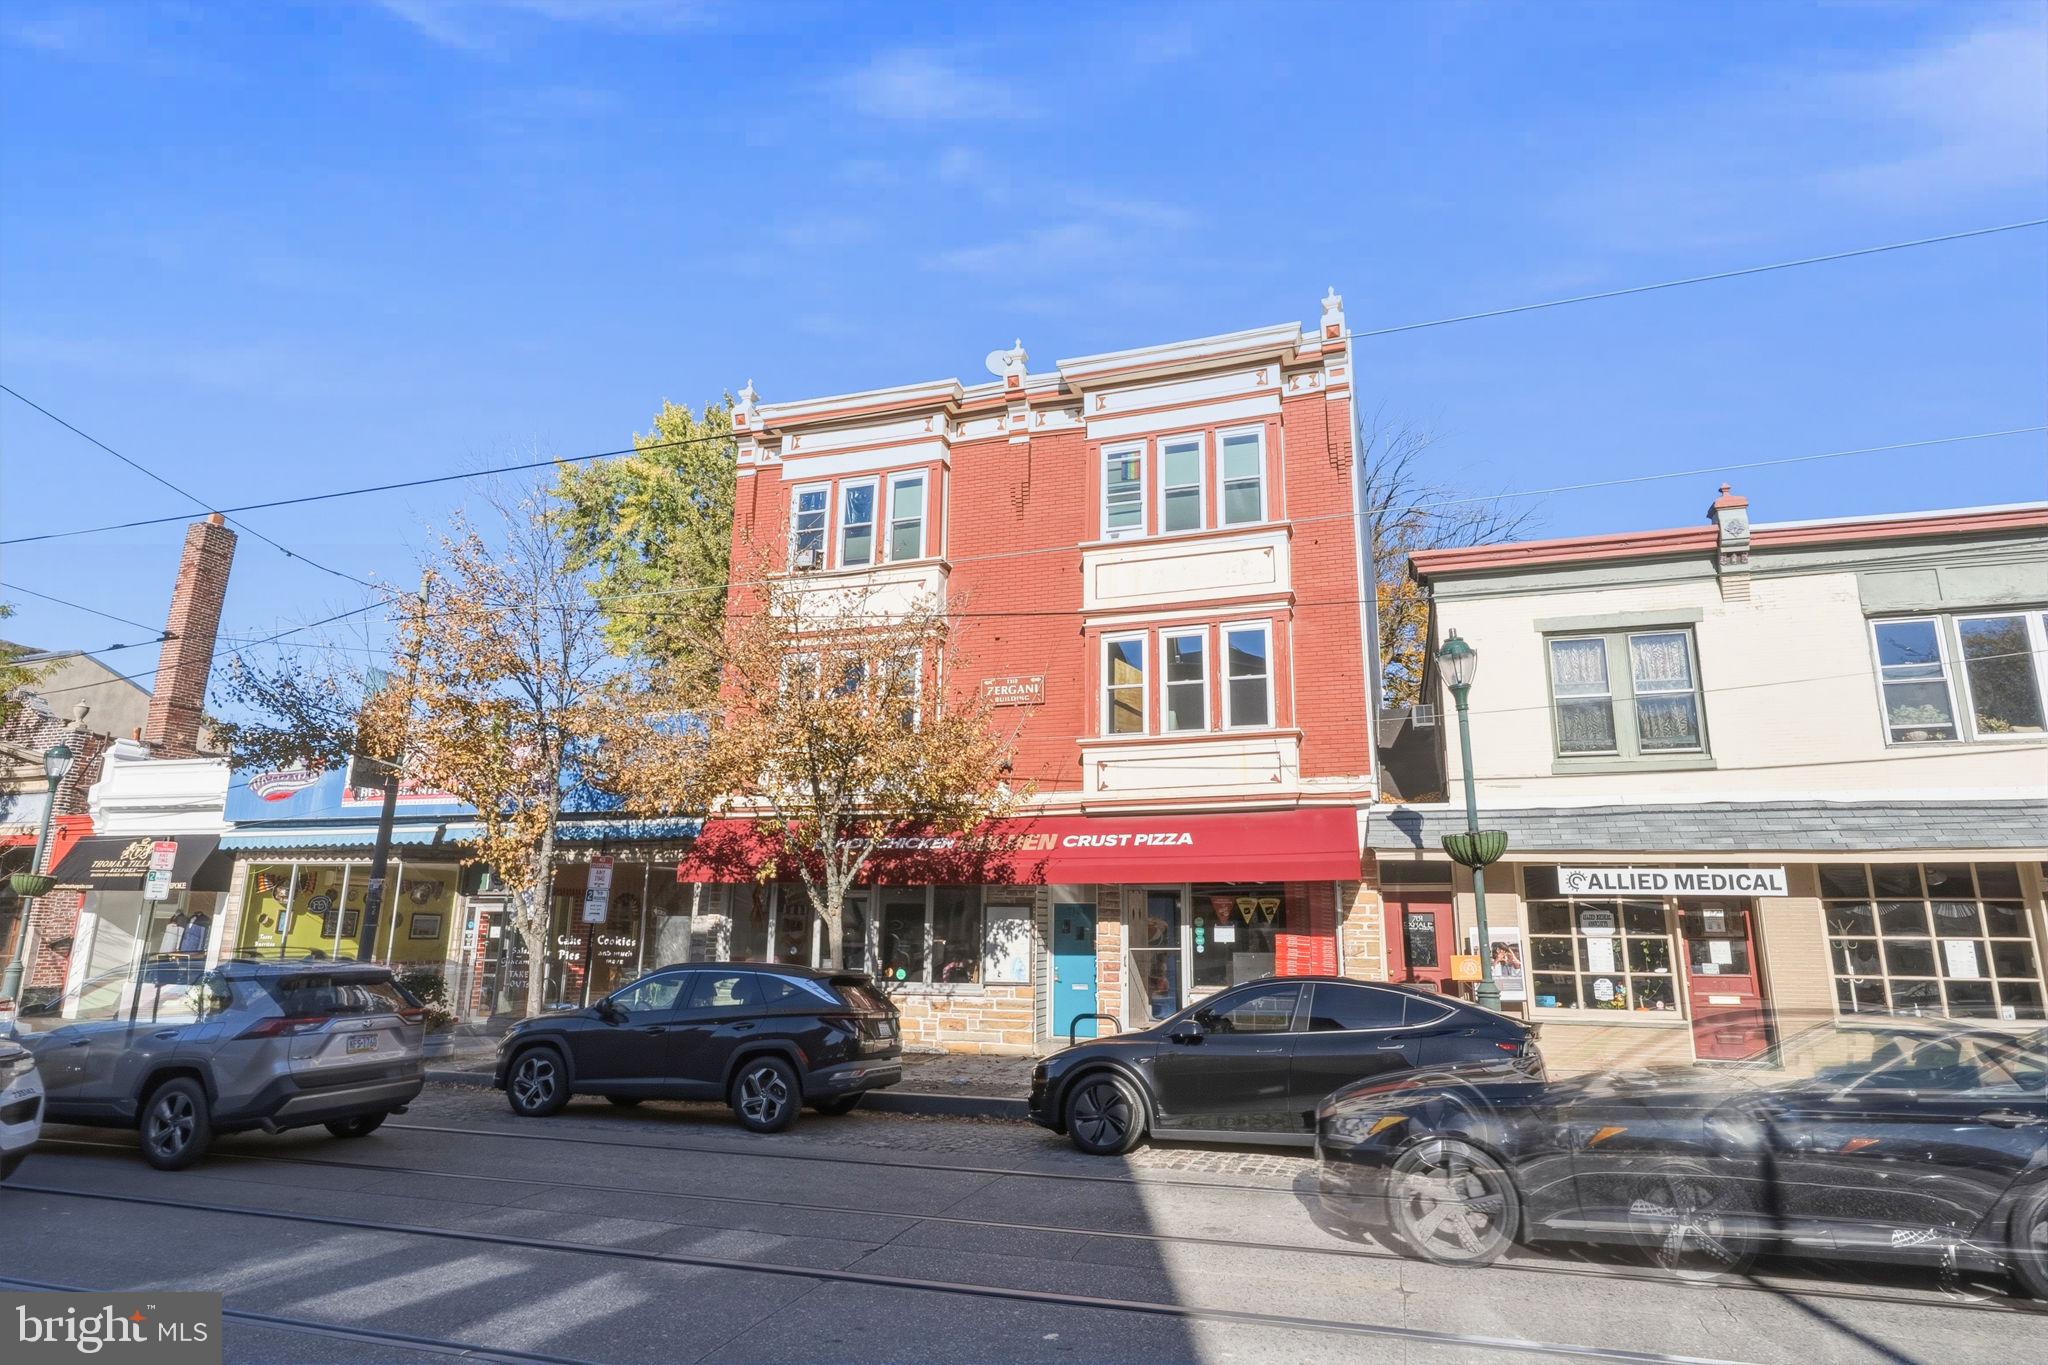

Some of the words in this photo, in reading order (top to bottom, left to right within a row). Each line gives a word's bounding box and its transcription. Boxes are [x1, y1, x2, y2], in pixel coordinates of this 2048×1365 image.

[987, 684, 1038, 696] ZERGANI
[835, 837, 871, 849] HOT
[878, 837, 955, 849] CHICKEN
[1063, 834, 1132, 849] CRUST
[1134, 833, 1194, 846] PIZZA
[92, 860, 126, 868] THOMAS
[127, 859, 150, 868] TILL
[1588, 873, 1668, 890] ALLIED
[1674, 873, 1782, 891] MEDICAL
[597, 935, 636, 947] Cookies
[558, 949, 580, 960] Pies
